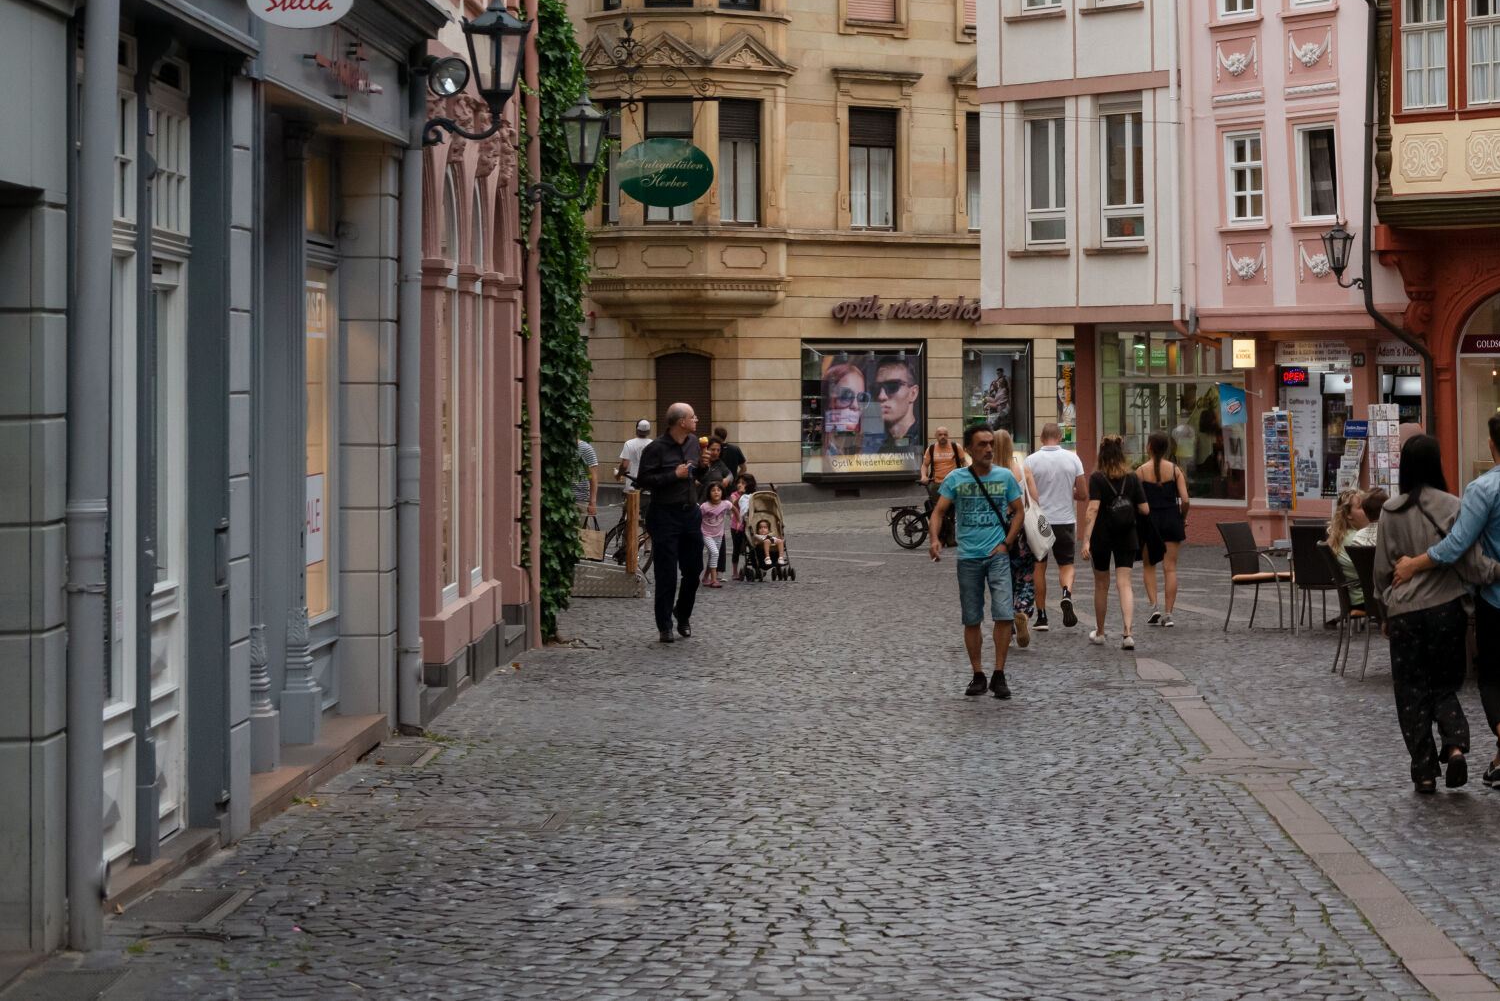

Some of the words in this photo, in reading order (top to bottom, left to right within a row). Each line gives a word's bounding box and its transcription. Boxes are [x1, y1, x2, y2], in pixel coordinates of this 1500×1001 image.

[832, 295, 884, 325] optik
[887, 294, 981, 324] niederhö
[1378, 346, 1400, 356] Adam's
[1283, 372, 1305, 381] OPEN
[305, 498, 320, 535] ALE
